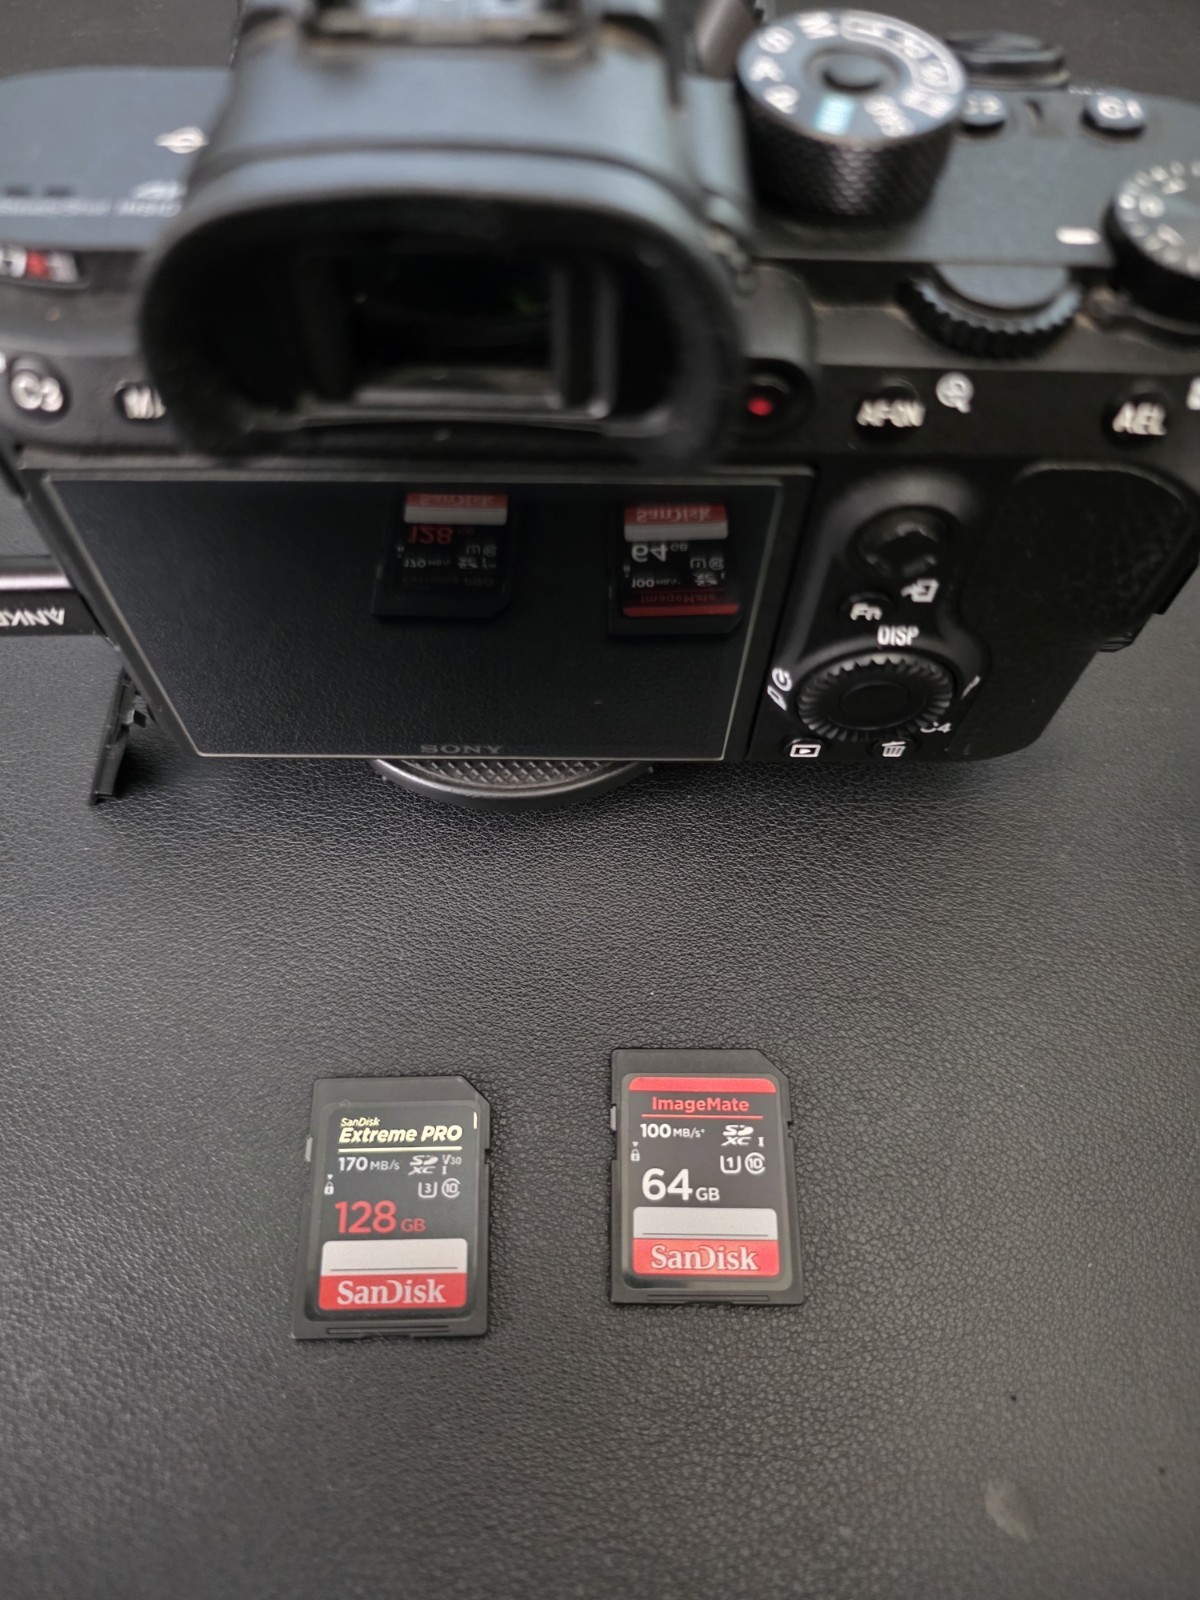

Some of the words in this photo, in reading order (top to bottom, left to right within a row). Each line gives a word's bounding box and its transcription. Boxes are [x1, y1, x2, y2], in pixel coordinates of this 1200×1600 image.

[11, 372, 63, 412] C3
[850, 603, 882, 620] Fn
[877, 625, 919, 646] DISP
[420, 744, 501, 754] SONY
[652, 1096, 750, 1114] ImageMate
[340, 1117, 380, 1127] SanDisk
[640, 1123, 672, 1138] 100
[339, 1128, 417, 1144] Extreme
[420, 1125, 463, 1142] PRO
[338, 1157, 367, 1171] 170
[641, 1168, 693, 1201] 64
[695, 1186, 720, 1201] GB
[334, 1200, 397, 1234] 128
[401, 1218, 426, 1232] GB
[651, 1244, 759, 1271] SanDisk
[337, 1279, 447, 1305] SanDisk
